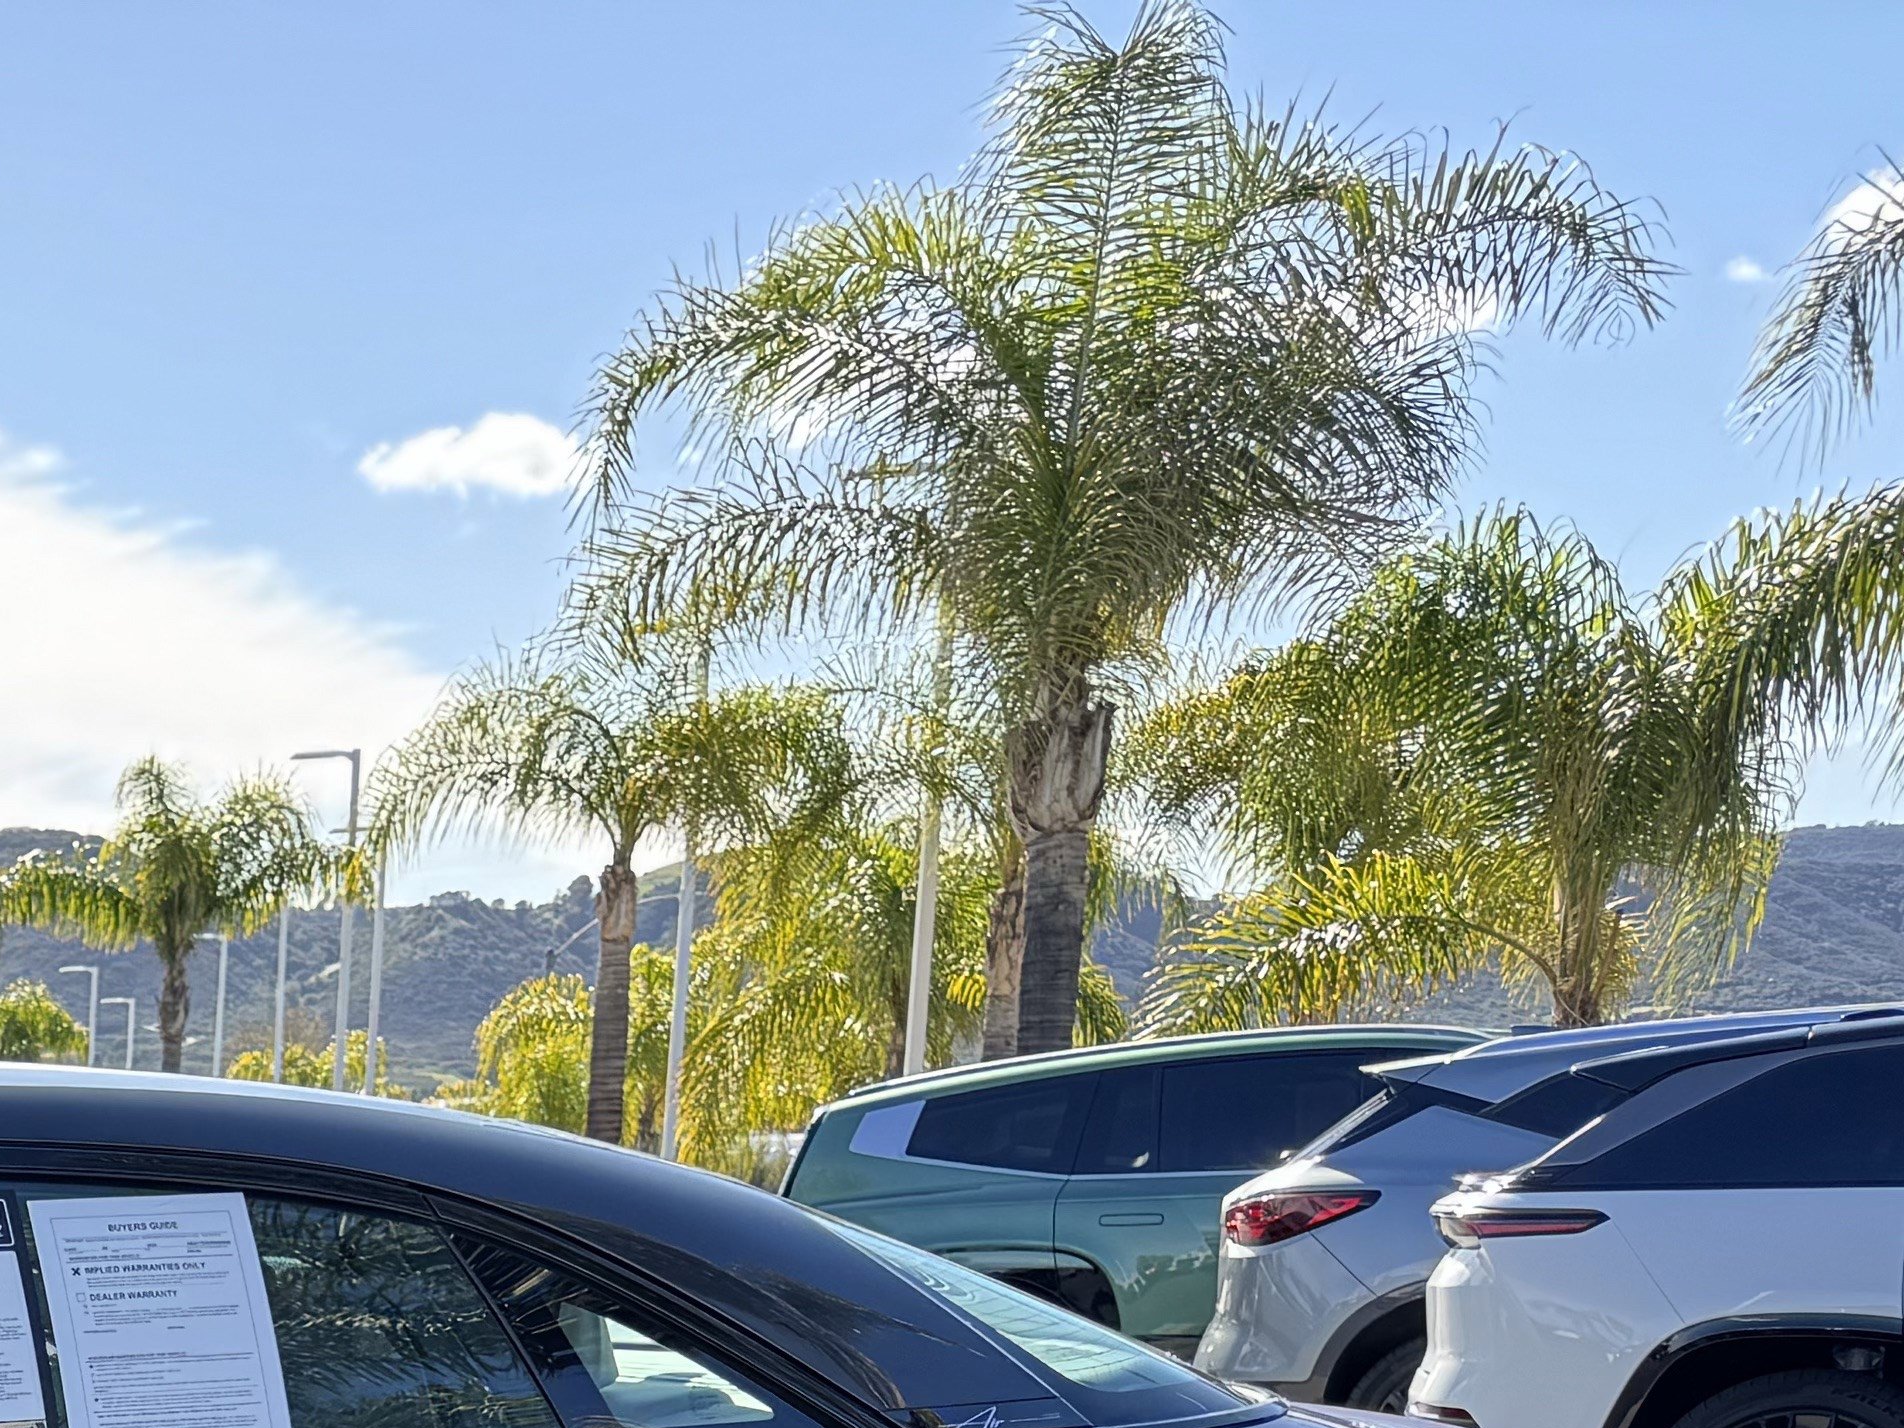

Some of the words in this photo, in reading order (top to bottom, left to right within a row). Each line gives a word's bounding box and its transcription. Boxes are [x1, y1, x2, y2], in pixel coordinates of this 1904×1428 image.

[108, 1222, 147, 1232] BUYERS
[149, 1221, 179, 1230] GUIDE
[84, 1265, 120, 1275] IMPLIED
[122, 1263, 180, 1273] WARRANTIES
[182, 1261, 206, 1270] ONLY
[89, 1291, 126, 1302] DEALER
[128, 1289, 178, 1300] WARRANTY
